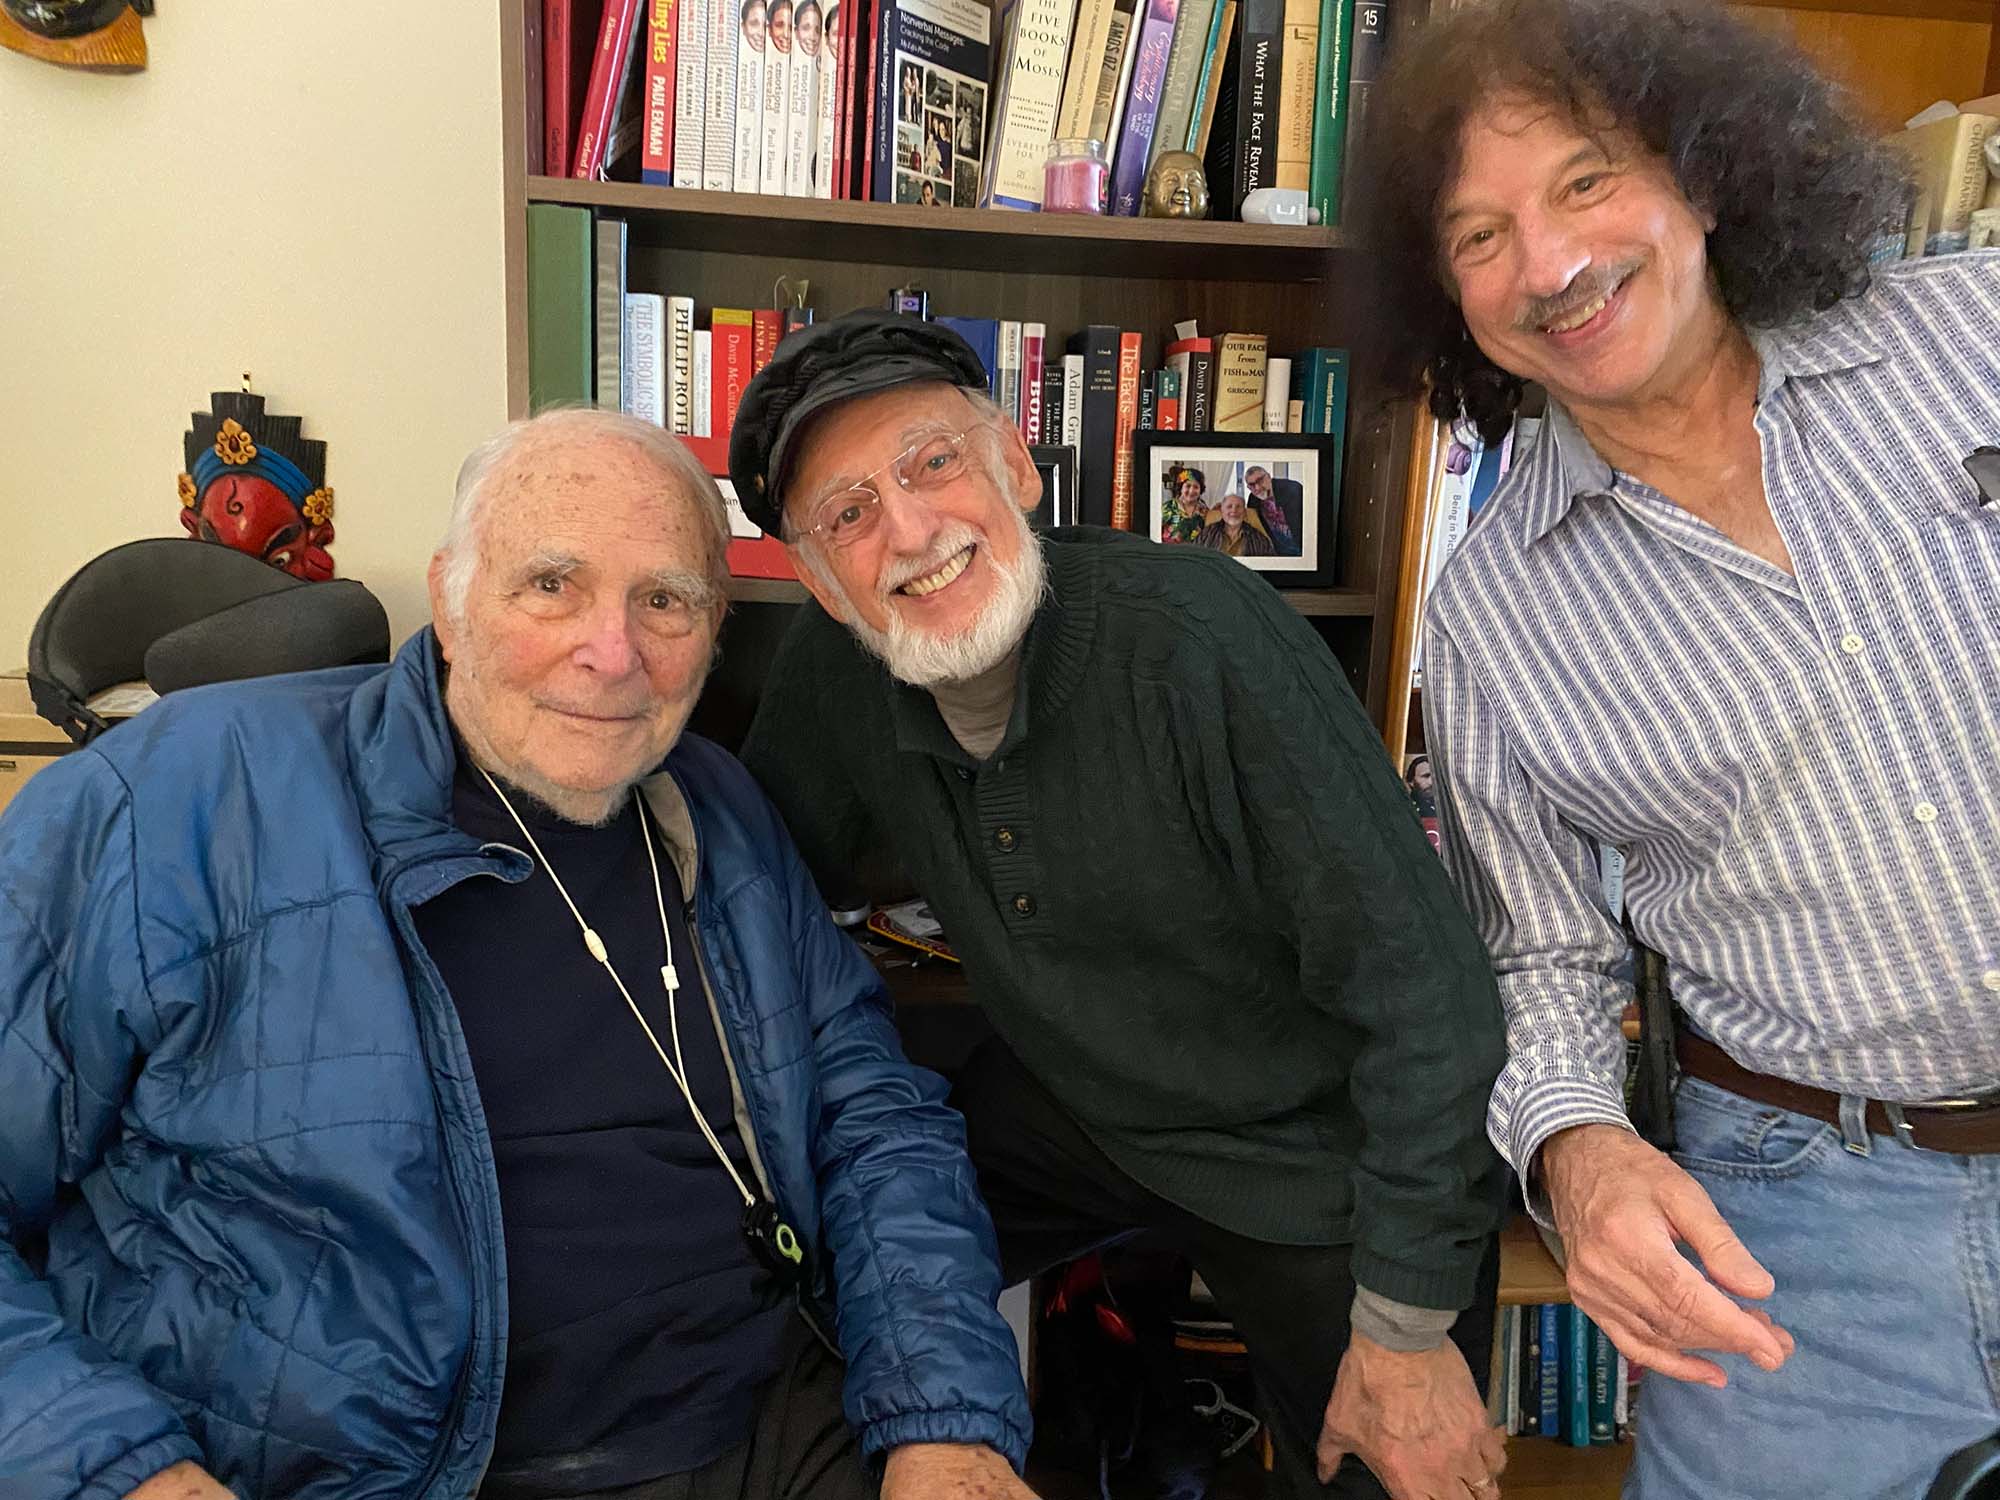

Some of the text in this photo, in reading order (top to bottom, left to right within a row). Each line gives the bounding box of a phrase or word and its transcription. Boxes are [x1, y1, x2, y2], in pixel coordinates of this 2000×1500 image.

[900, 11, 933, 34] Nonverbal
[1031, 12, 1060, 28] FIVE
[1363, 9, 1377, 26] 15
[654, 32, 672, 64] Lies
[900, 25, 924, 44] Cracking
[1020, 28, 1066, 46] BOOKS
[1105, 21, 1124, 54] AMOS
[1015, 56, 1060, 78] MOSES
[1033, 48, 1046, 57] OF
[1103, 56, 1116, 71] OZ
[1144, 31, 1170, 104] Evolutionary
[740, 63, 748, 109] revealed
[749, 60, 758, 113] emotions
[773, 61, 783, 114] emotions
[1332, 54, 1340, 88] Nonverbal
[765, 65, 774, 111] revealed
[791, 67, 800, 113] revealed
[800, 64, 809, 117] emotions
[822, 72, 831, 118] revealed
[1292, 60, 1304, 149] AND PERSONALITY
[649, 75, 666, 156] PAUL EKMAN
[1249, 41, 1268, 193] WHAT THE FACE REVEALS
[742, 128, 750, 147] Paul
[1006, 138, 1045, 153] EVERETT
[1965, 124, 1983, 174] CHARLES
[766, 128, 776, 181] Paul Ekman
[792, 129, 802, 183] Paul Ekman
[1016, 150, 1033, 159] FOX
[1956, 176, 1973, 223] DARWIN
[636, 302, 653, 329] THE
[728, 334, 740, 364] DAVID
[1121, 345, 1139, 375] The
[1227, 343, 1245, 351] OUR
[1238, 354, 1256, 363] from
[636, 333, 653, 400] SYMBOLIC
[674, 307, 689, 435] PHILIP ROTH
[1196, 361, 1208, 389] DAVID
[1223, 368, 1241, 376] FISH
[1249, 369, 1265, 377] MAN
[1068, 368, 1081, 410] Adam
[1120, 377, 1138, 414] Facts
[1227, 387, 1258, 395] GREGORY
[1141, 388, 1153, 430] Ian McE
[1114, 449, 1133, 488] Philip
[1114, 491, 1129, 524] Roth
[1448, 494, 1462, 522] Being
[1449, 522, 1458, 532] in
